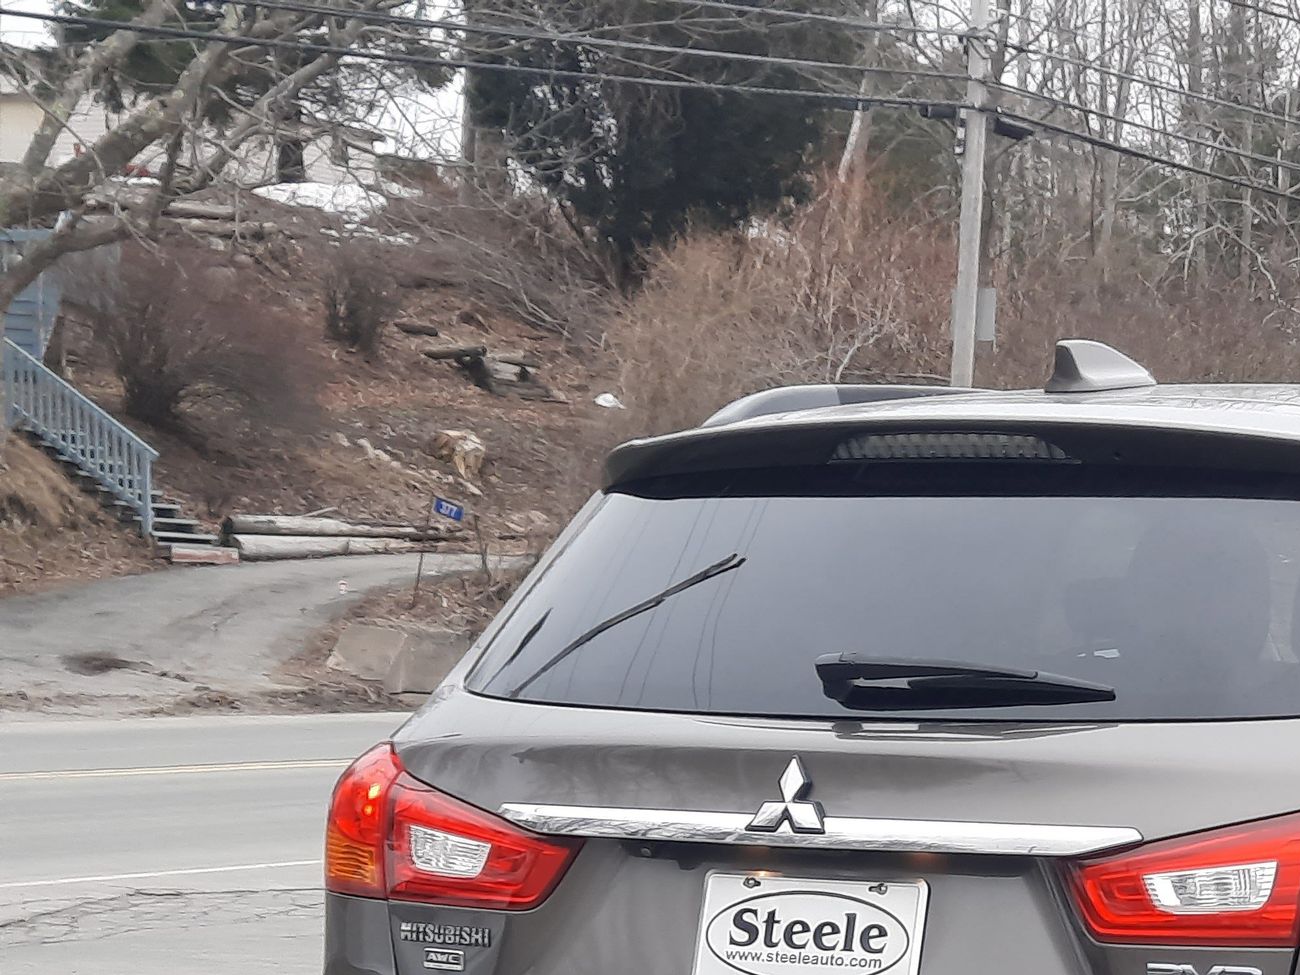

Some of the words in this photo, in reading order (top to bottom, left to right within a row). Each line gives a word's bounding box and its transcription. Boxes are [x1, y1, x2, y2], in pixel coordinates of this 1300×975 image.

[400, 922, 490, 947] MITSUBISHI
[729, 907, 888, 954] Steele
[427, 952, 460, 963] AWC
[726, 950, 882, 969] www.steeleauto.com
